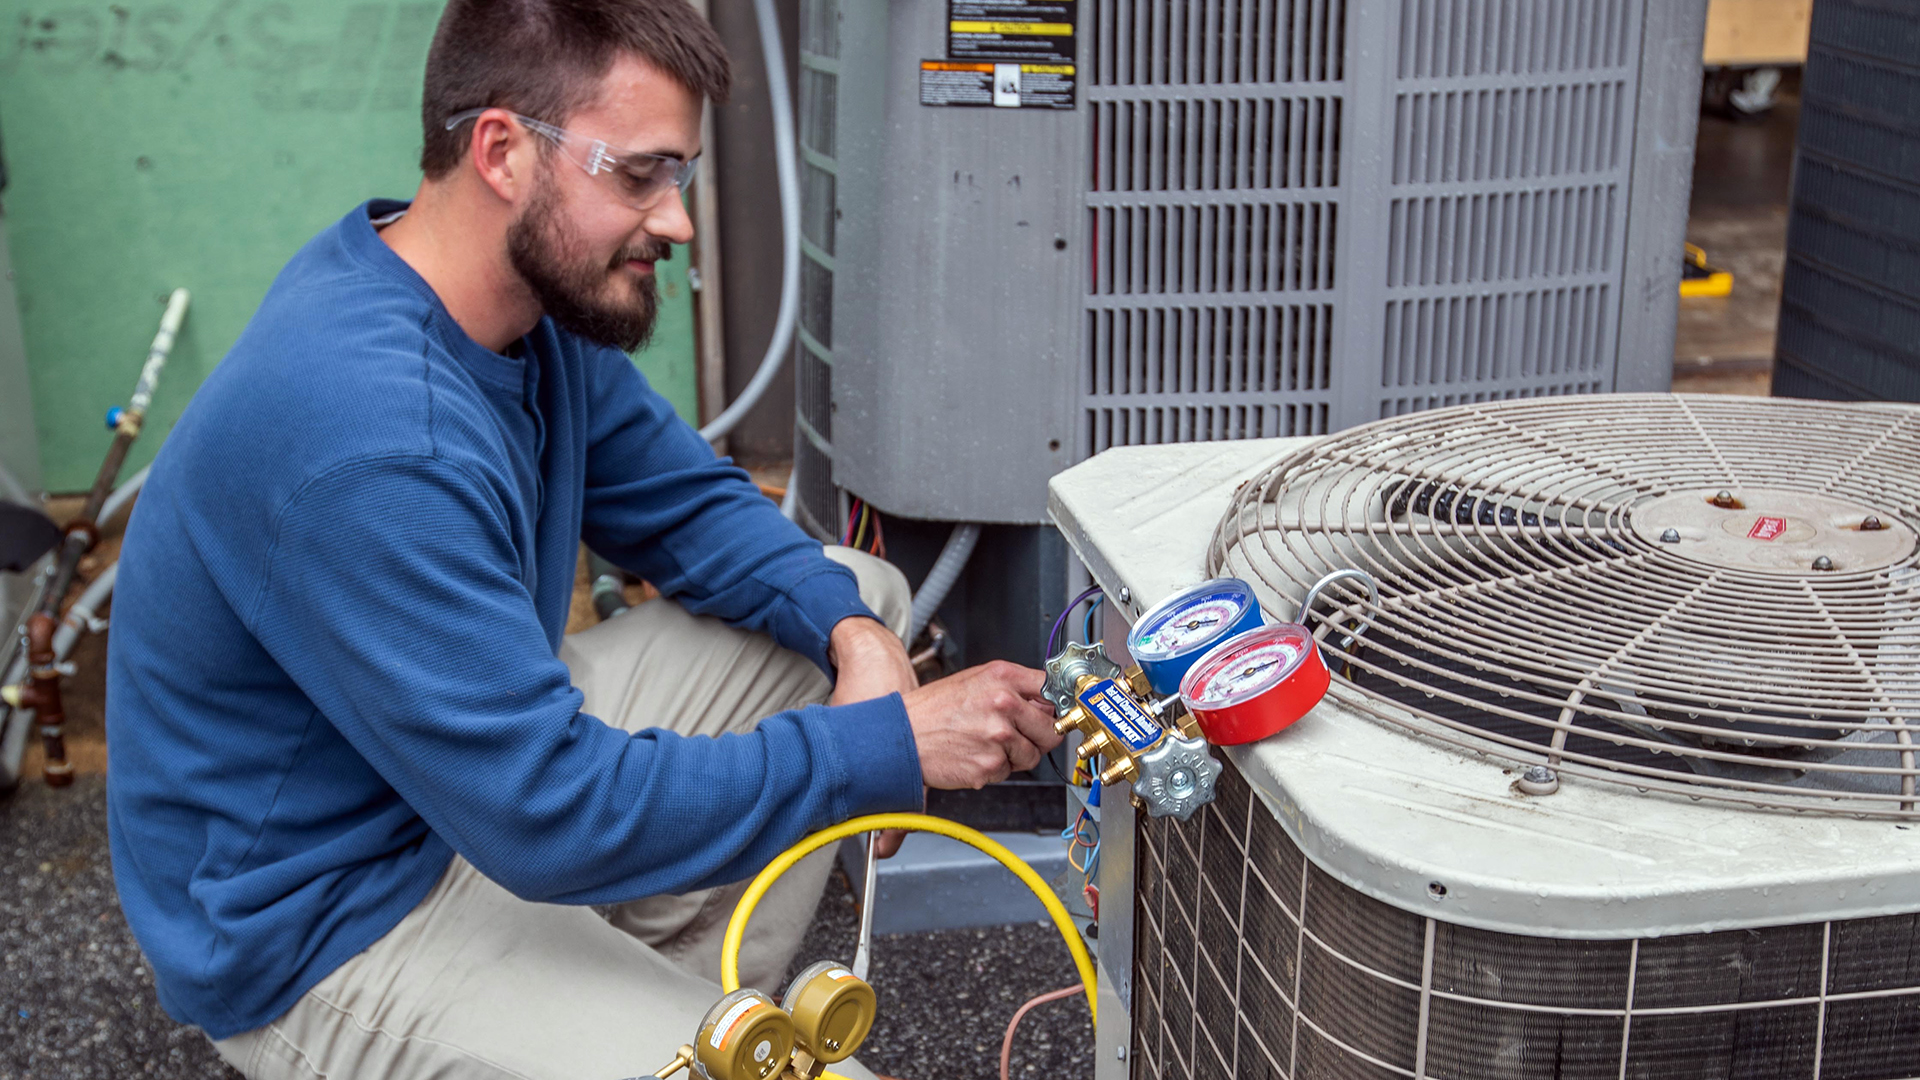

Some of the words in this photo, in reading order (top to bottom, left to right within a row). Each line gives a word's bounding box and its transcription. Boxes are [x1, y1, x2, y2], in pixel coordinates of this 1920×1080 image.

[1105, 685, 1118, 698] Test
[1112, 694, 1125, 704] and
[1119, 700, 1140, 721] Charging
[1097, 700, 1122, 724] YELLOW
[1115, 720, 1141, 743] JACKET
[1165, 752, 1210, 777] JACKET
